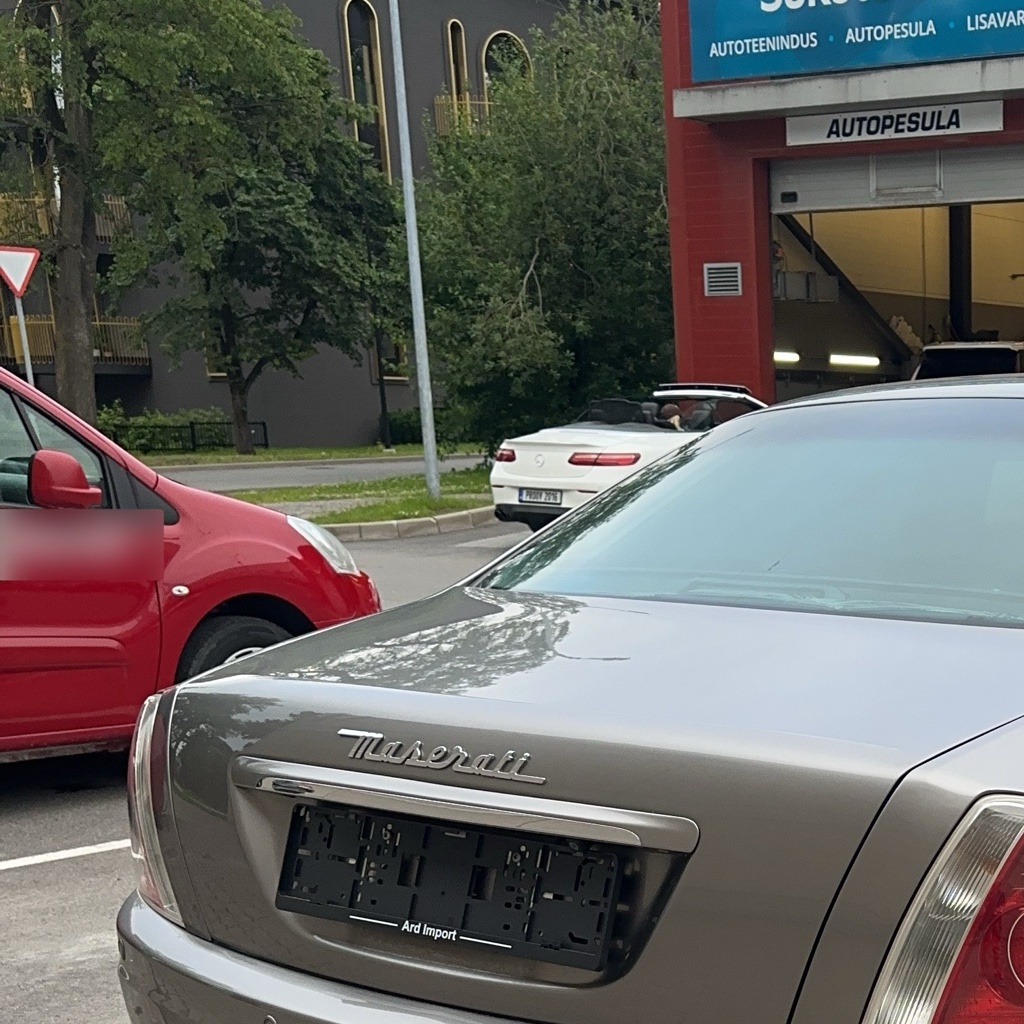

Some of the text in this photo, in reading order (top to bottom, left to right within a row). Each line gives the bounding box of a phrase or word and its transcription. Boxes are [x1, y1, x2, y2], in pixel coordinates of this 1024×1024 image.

[709, 32, 818, 58] AUTOTEENINDUS
[845, 19, 937, 44] AUTOPESULA
[826, 109, 961, 139] AUTOPESULA
[337, 728, 547, 785] Maserati
[401, 920, 457, 941] Ard Import
